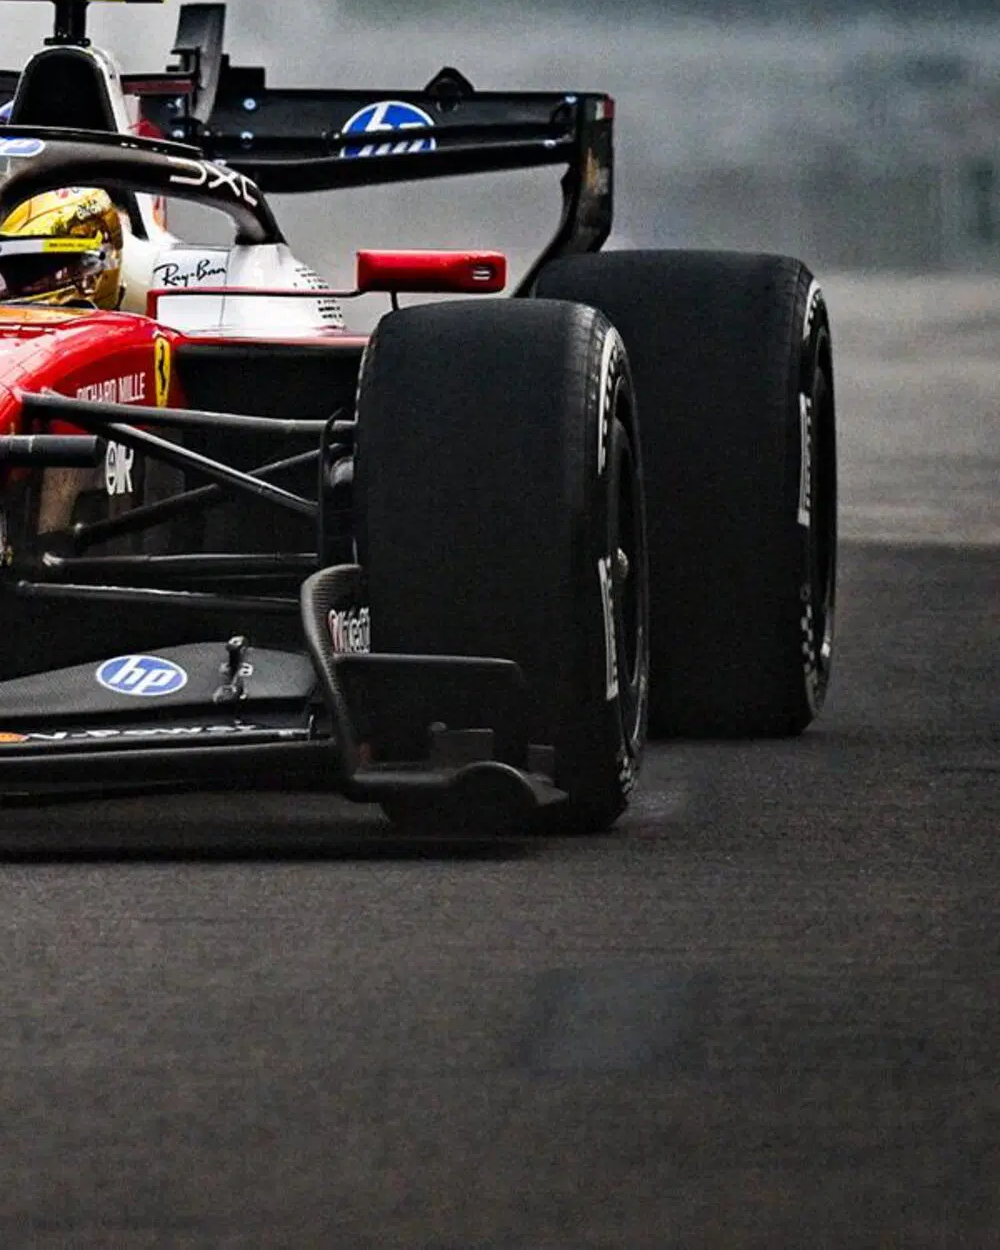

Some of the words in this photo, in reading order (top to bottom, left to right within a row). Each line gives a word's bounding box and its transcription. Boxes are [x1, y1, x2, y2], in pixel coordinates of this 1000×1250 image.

[167, 155, 258, 207] DXC
[118, 371, 146, 402] MILLE
[108, 655, 179, 696] hp
